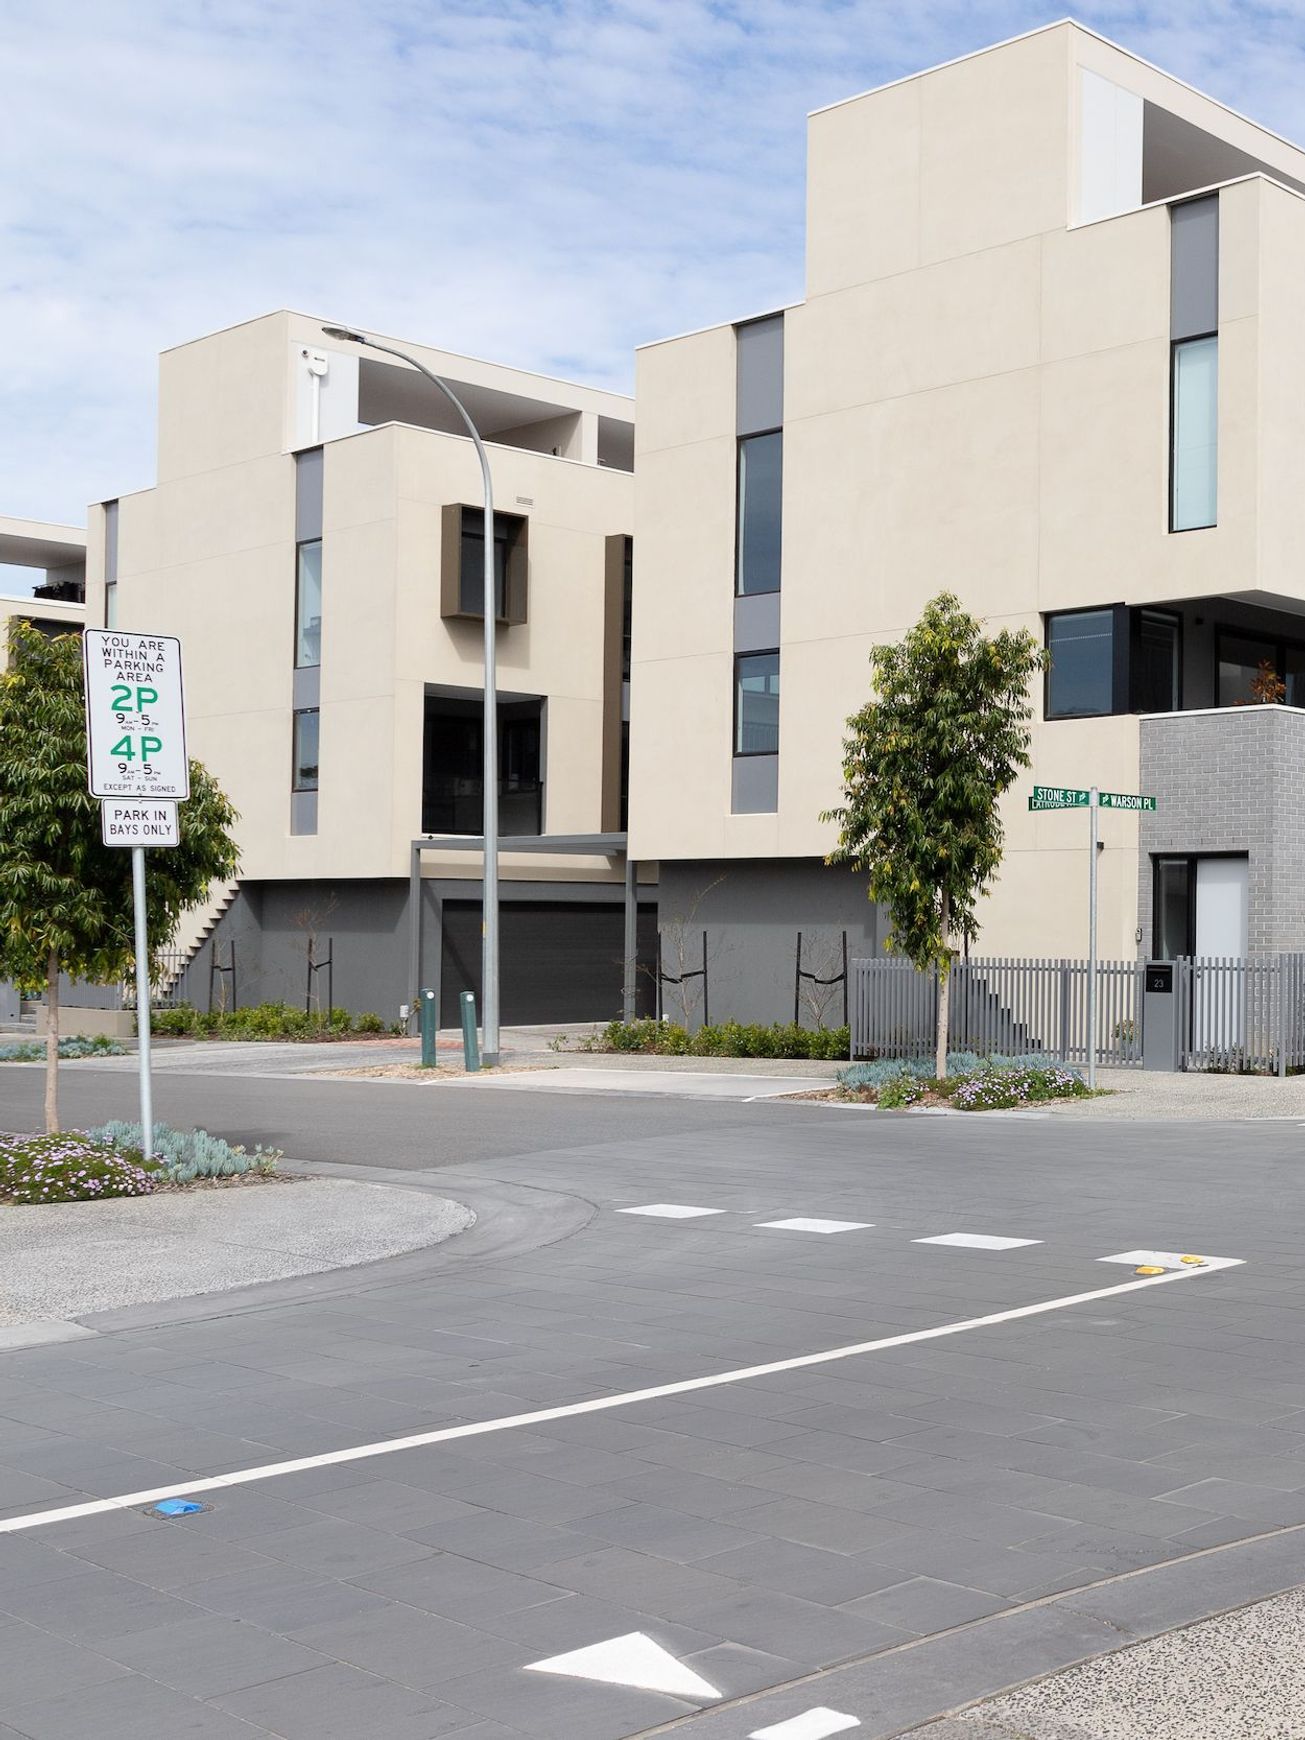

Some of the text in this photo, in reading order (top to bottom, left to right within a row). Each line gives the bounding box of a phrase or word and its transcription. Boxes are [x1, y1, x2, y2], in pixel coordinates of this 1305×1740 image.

[101, 635, 165, 651] YOU ARE
[102, 647, 165, 662] WITHIN A
[104, 659, 164, 673] PARKING
[116, 671, 153, 682] AREA
[110, 684, 158, 713] 2P
[110, 735, 162, 762] 4P
[103, 783, 132, 791] EXCEPT
[150, 785, 176, 793] SIGNED
[1037, 787, 1077, 803] STONE ST
[1110, 794, 1153, 810] WARSON PL
[114, 810, 167, 821] PARK IN
[110, 823, 172, 835] BAYS ONLY
[1154, 978, 1164, 988] 23
